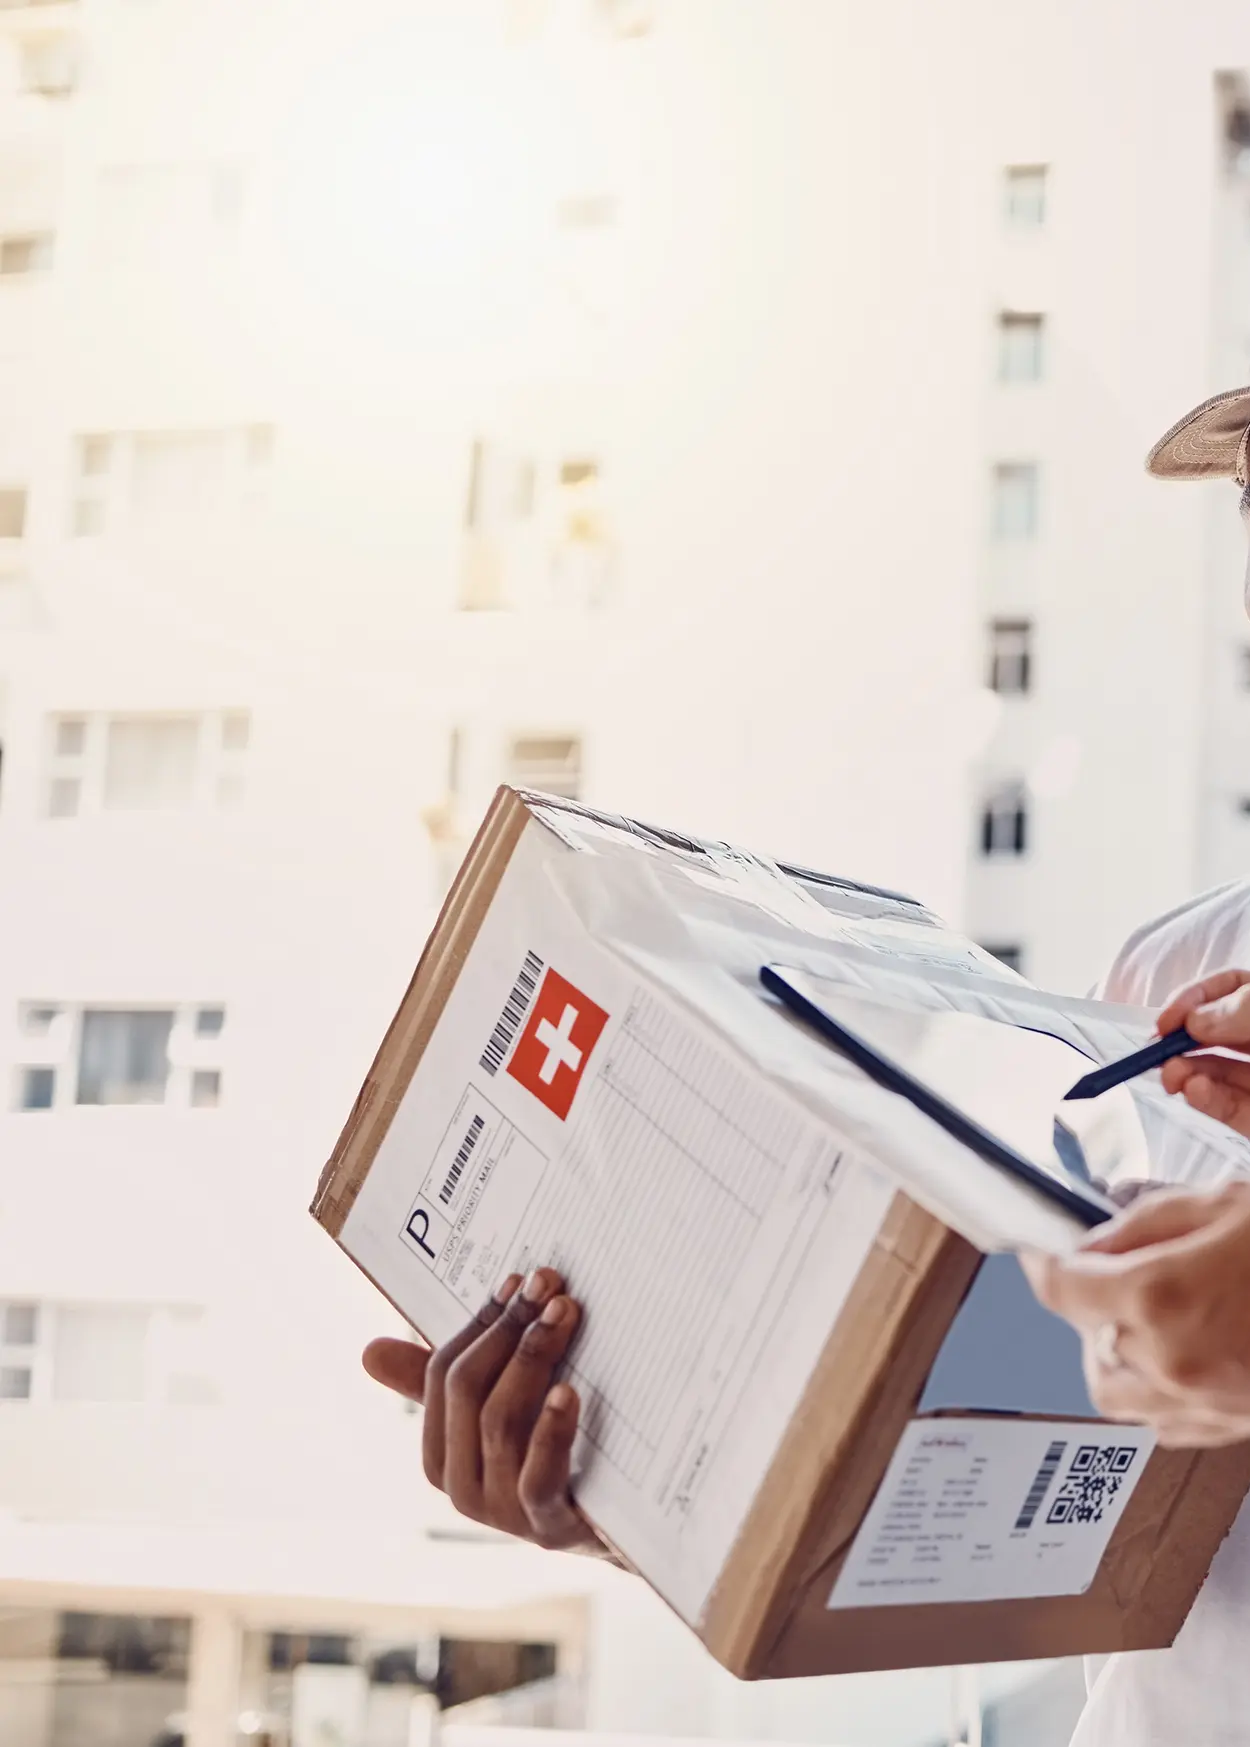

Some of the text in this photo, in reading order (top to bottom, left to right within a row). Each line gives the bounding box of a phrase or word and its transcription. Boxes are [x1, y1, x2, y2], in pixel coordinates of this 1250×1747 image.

[406, 1208, 436, 1259] P
[443, 1233, 458, 1262] USPS
[456, 1185, 482, 1232] PRIORITY
[478, 1157, 495, 1183] MAIL
